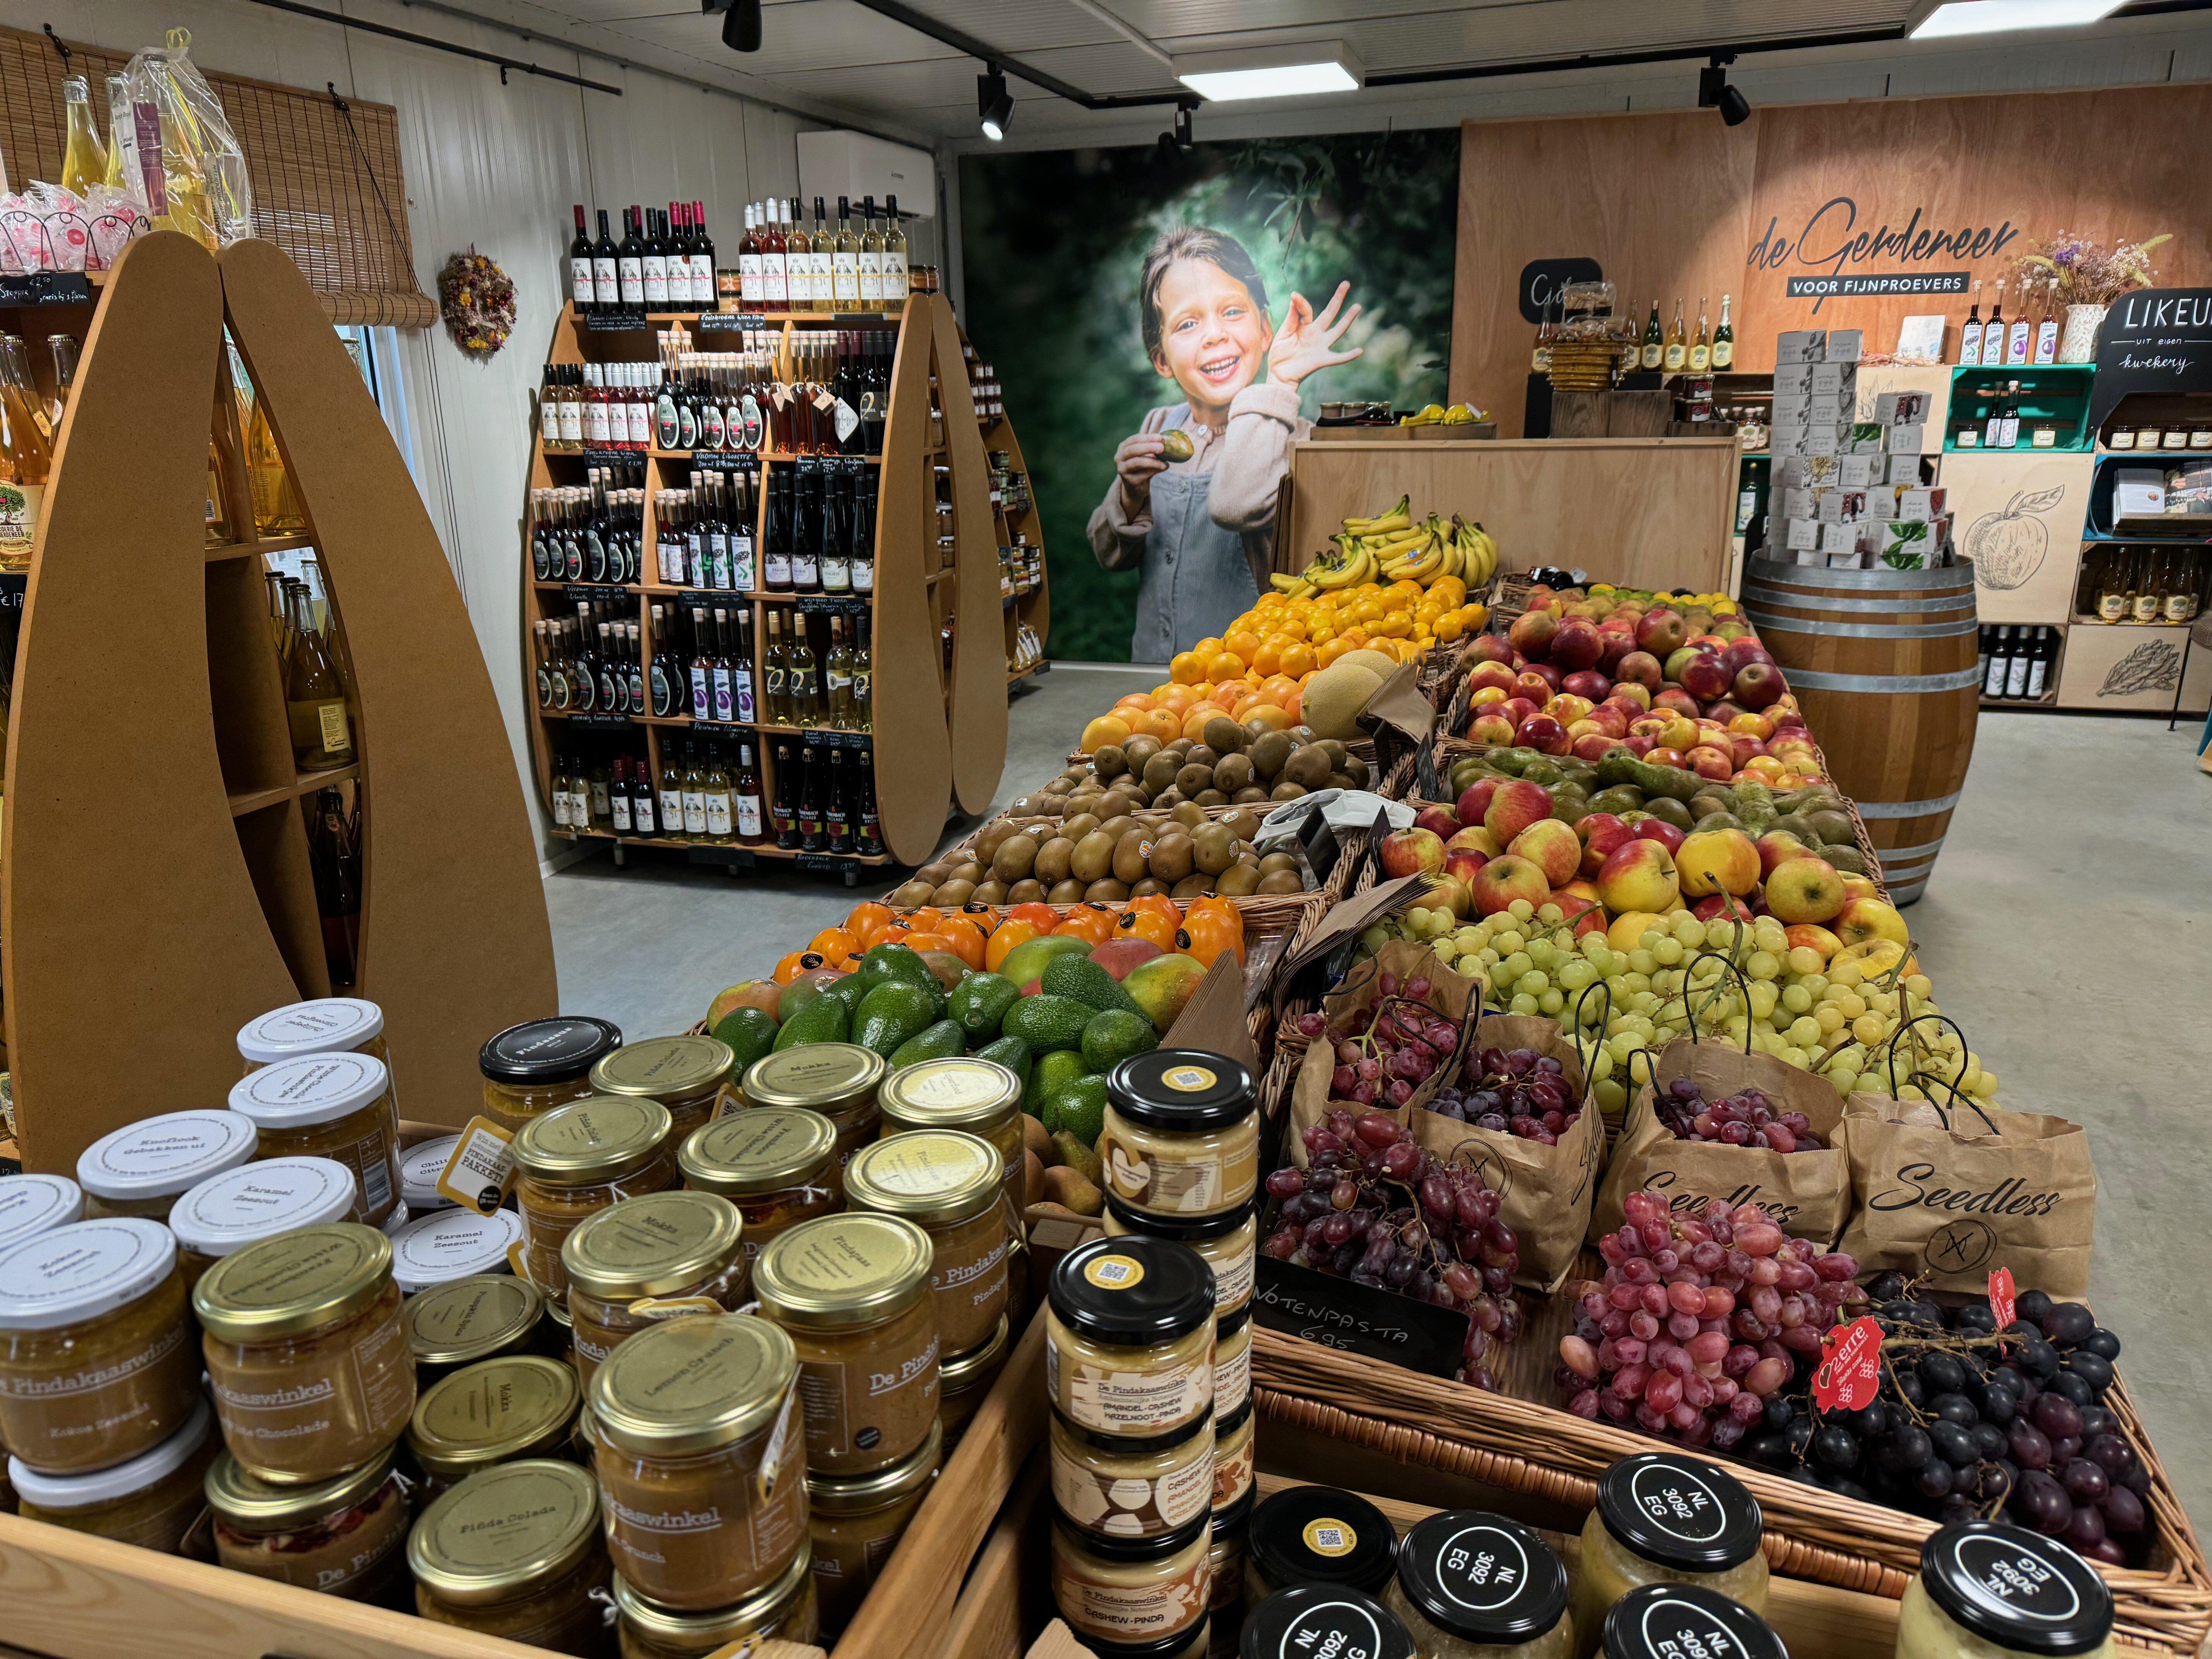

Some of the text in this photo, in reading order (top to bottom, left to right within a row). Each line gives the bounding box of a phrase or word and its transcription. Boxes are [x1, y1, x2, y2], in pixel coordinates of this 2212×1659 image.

[1747, 197, 2019, 315] de Gerdeneer
[1793, 277, 1962, 293] VOOR FIJNPROEVERS
[2125, 298, 2212, 328] LIKEU
[1, 596, 10, 606] €
[514, 1027, 572, 1055] Pindasaus
[124, 1145, 187, 1154] Gebakken
[141, 1136, 200, 1145] Knoflook
[421, 1159, 447, 1168] Chili
[461, 1157, 503, 1183] PAKKET!
[467, 1148, 507, 1172] PINDAKAAS-
[232, 1195, 279, 1204] Zeezout
[243, 1185, 294, 1195] Karamel
[1869, 1162, 2066, 1217] Seedless
[433, 1239, 479, 1249] Zeezout
[434, 1230, 483, 1240] Karamel
[833, 1234, 872, 1267] Pindapaas
[1252, 1283, 1408, 1343] NOTENPASTA
[1850, 1334, 1869, 1357] VEGETABLES
[869, 1372, 895, 1390] De
[1216, 1358, 1247, 1382] HEW-PINDA
[213, 1379, 334, 1408] kaaswinkel
[644, 1368, 688, 1398] Lemon
[1113, 1378, 1186, 1394] Pindakaaswinkel
[500, 1383, 511, 1413] Mokka
[604, 1490, 721, 1528] kaaswinkel
[1644, 1495, 1668, 1516] EG
[1662, 1487, 1693, 1519] 3092
[1688, 1491, 1708, 1510] NL
[460, 1505, 556, 1534] Piñda Colada
[1447, 1548, 1470, 1570] EG
[1468, 1551, 1495, 1585] 3092
[2017, 1558, 2051, 1581] EG
[318, 1567, 345, 1587] De
[1494, 1566, 1516, 1584] NL
[1987, 1575, 2013, 1598] NL
[1992, 1559, 2040, 1596] 3092
[1096, 1592, 1168, 1604] Pindakaaswinkel
[1295, 1627, 1321, 1650] NL
[1677, 1629, 1709, 1659] 309
[1705, 1630, 1729, 1656] NL
[1345, 1647, 1367, 1659] G
